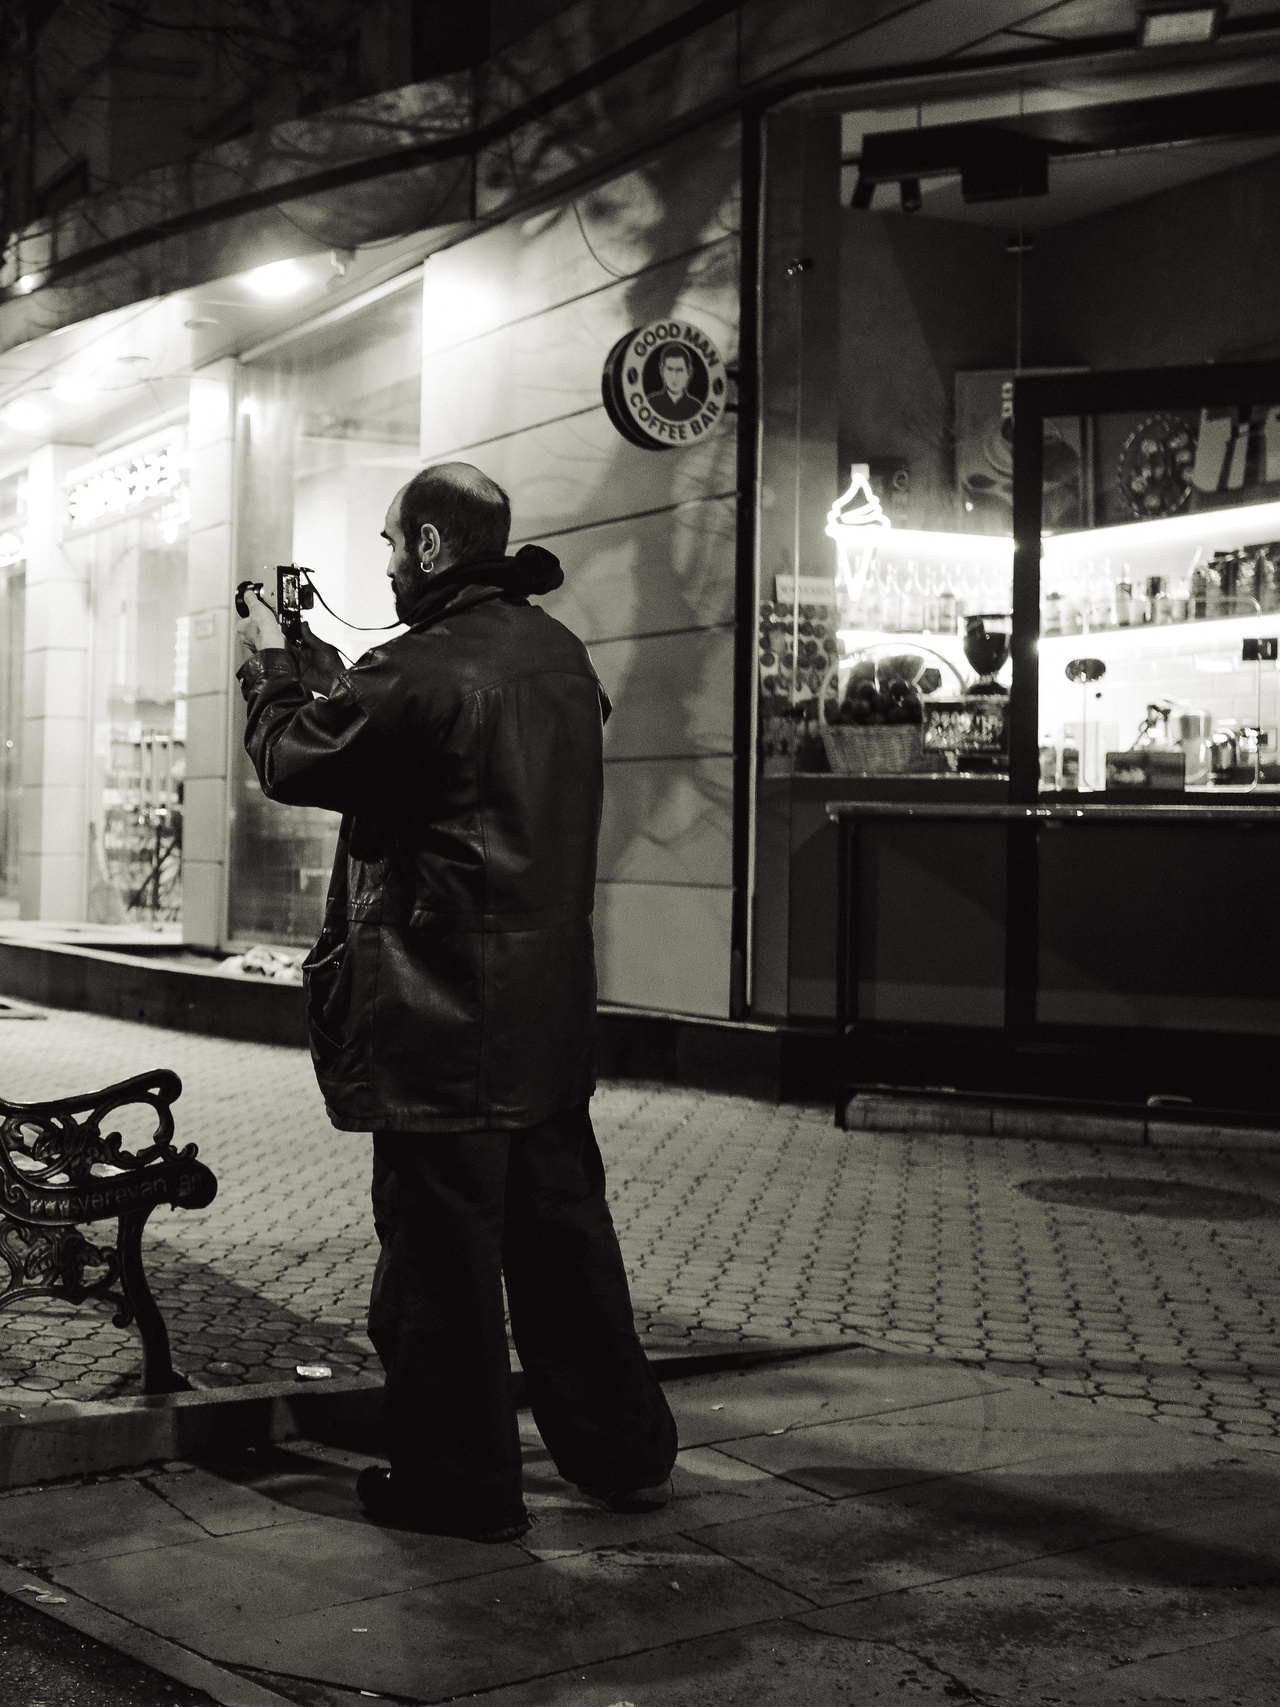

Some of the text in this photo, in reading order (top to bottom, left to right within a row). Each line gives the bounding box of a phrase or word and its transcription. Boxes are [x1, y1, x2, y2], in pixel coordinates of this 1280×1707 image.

[634, 322, 720, 367] GOOD MAN
[630, 392, 720, 440] COFFEE BAR
